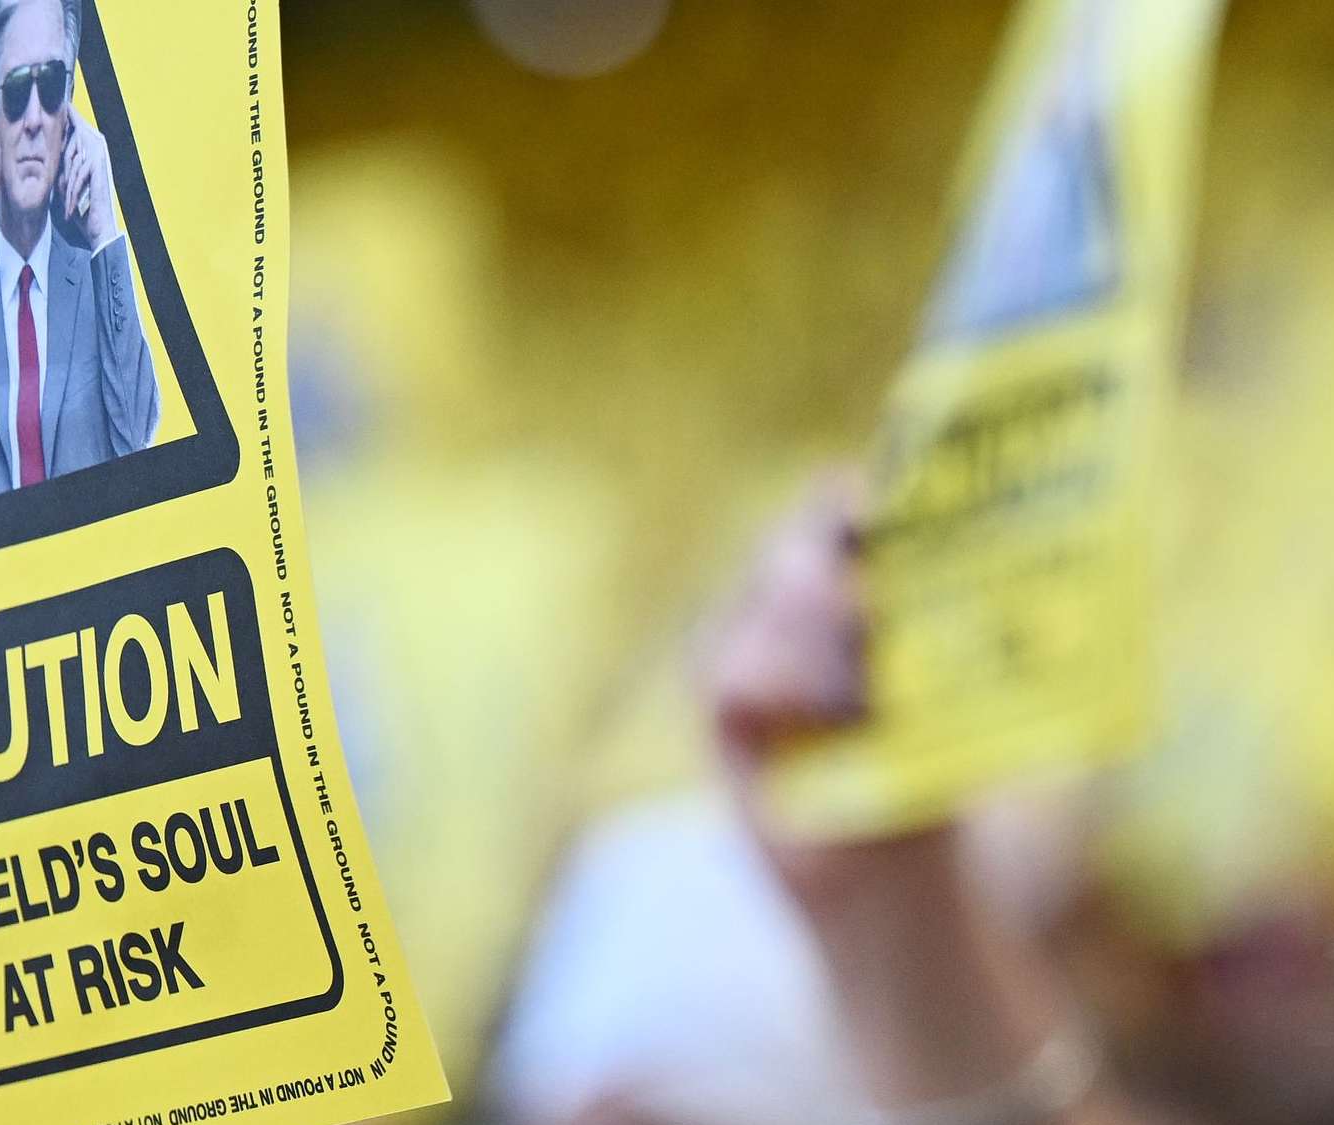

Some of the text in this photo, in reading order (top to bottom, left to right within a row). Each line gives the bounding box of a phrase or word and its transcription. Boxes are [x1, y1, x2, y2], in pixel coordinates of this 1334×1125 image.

[248, 73, 259, 96] IN
[250, 100, 262, 145] THE
[252, 150, 265, 245] GROUND
[253, 256, 264, 301] NOT
[252, 307, 263, 323] A
[253, 326, 266, 404] POUND
[257, 409, 269, 432] IN
[260, 434, 275, 482] THE
[267, 485, 286, 581] GROUND
[280, 592, 299, 638] NOT
[288, 643, 299, 659] A
[292, 662, 314, 740] POUND
[306, 744, 320, 767] IN
[313, 770, 334, 817] THE
[131, 799, 280, 893] SOUL
[326, 819, 362, 914] GROUND
[358, 922, 382, 967] NOT
[3, 922, 205, 1034] AT RISK
[372, 972, 386, 988] A
[377, 991, 398, 1064] POUND
[259, 1087, 275, 1107] IN
[276, 1076, 325, 1103] POUND
[323, 1073, 335, 1091] A
[337, 1066, 366, 1089] NOT
[228, 1091, 259, 1114] THE
